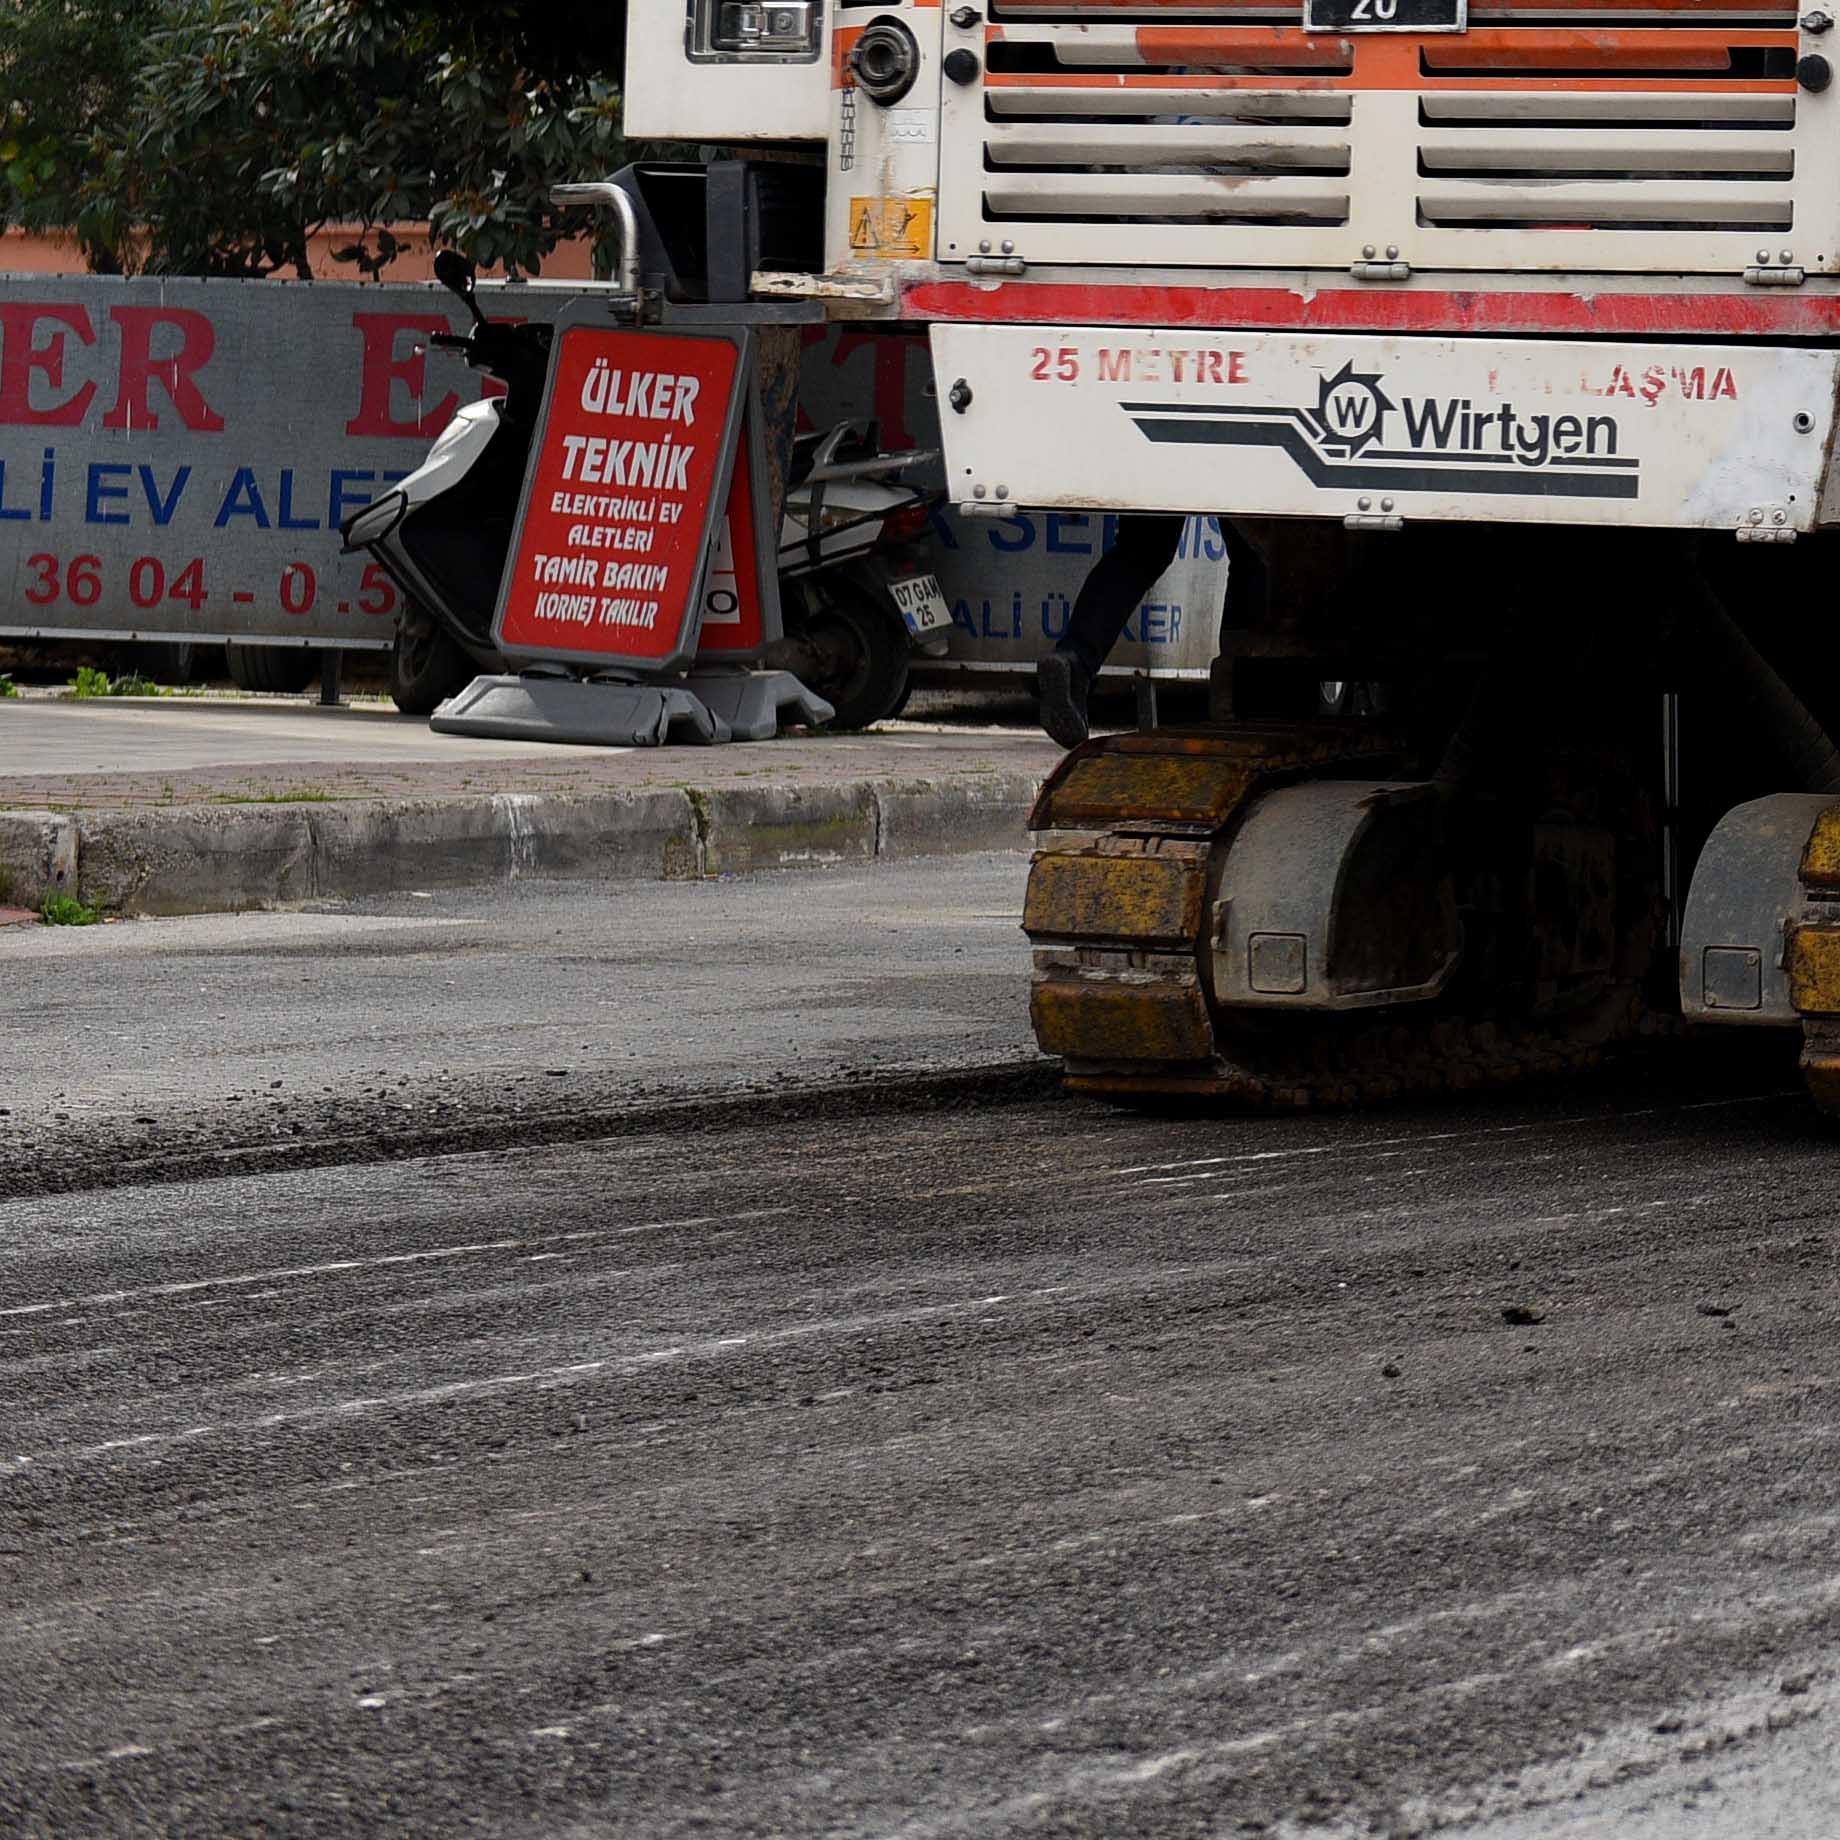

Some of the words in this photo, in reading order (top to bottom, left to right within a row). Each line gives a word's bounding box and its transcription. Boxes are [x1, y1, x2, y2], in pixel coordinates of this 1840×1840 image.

[1030, 347, 1081, 381] 25
[1097, 348, 1251, 384] METRE
[580, 358, 700, 427] ÜLKER
[1401, 396, 1618, 467] Wirtgen
[562, 432, 695, 491] TEKNİK
[84, 463, 193, 526] EV
[550, 491, 656, 521] ELEKTRİKLİ
[658, 503, 683, 524] EV
[567, 524, 654, 553] ALETLERİ
[24, 553, 102, 607] 36
[128, 556, 209, 610] 04
[533, 553, 599, 587] TAMİR
[602, 562, 669, 592] BAKIM
[534, 592, 597, 628] KORNEJ
[598, 598, 659, 630] TAKILIR
[896, 585, 913, 607] 07
[916, 604, 936, 627] 25
[949, 591, 1022, 641] ALİ
